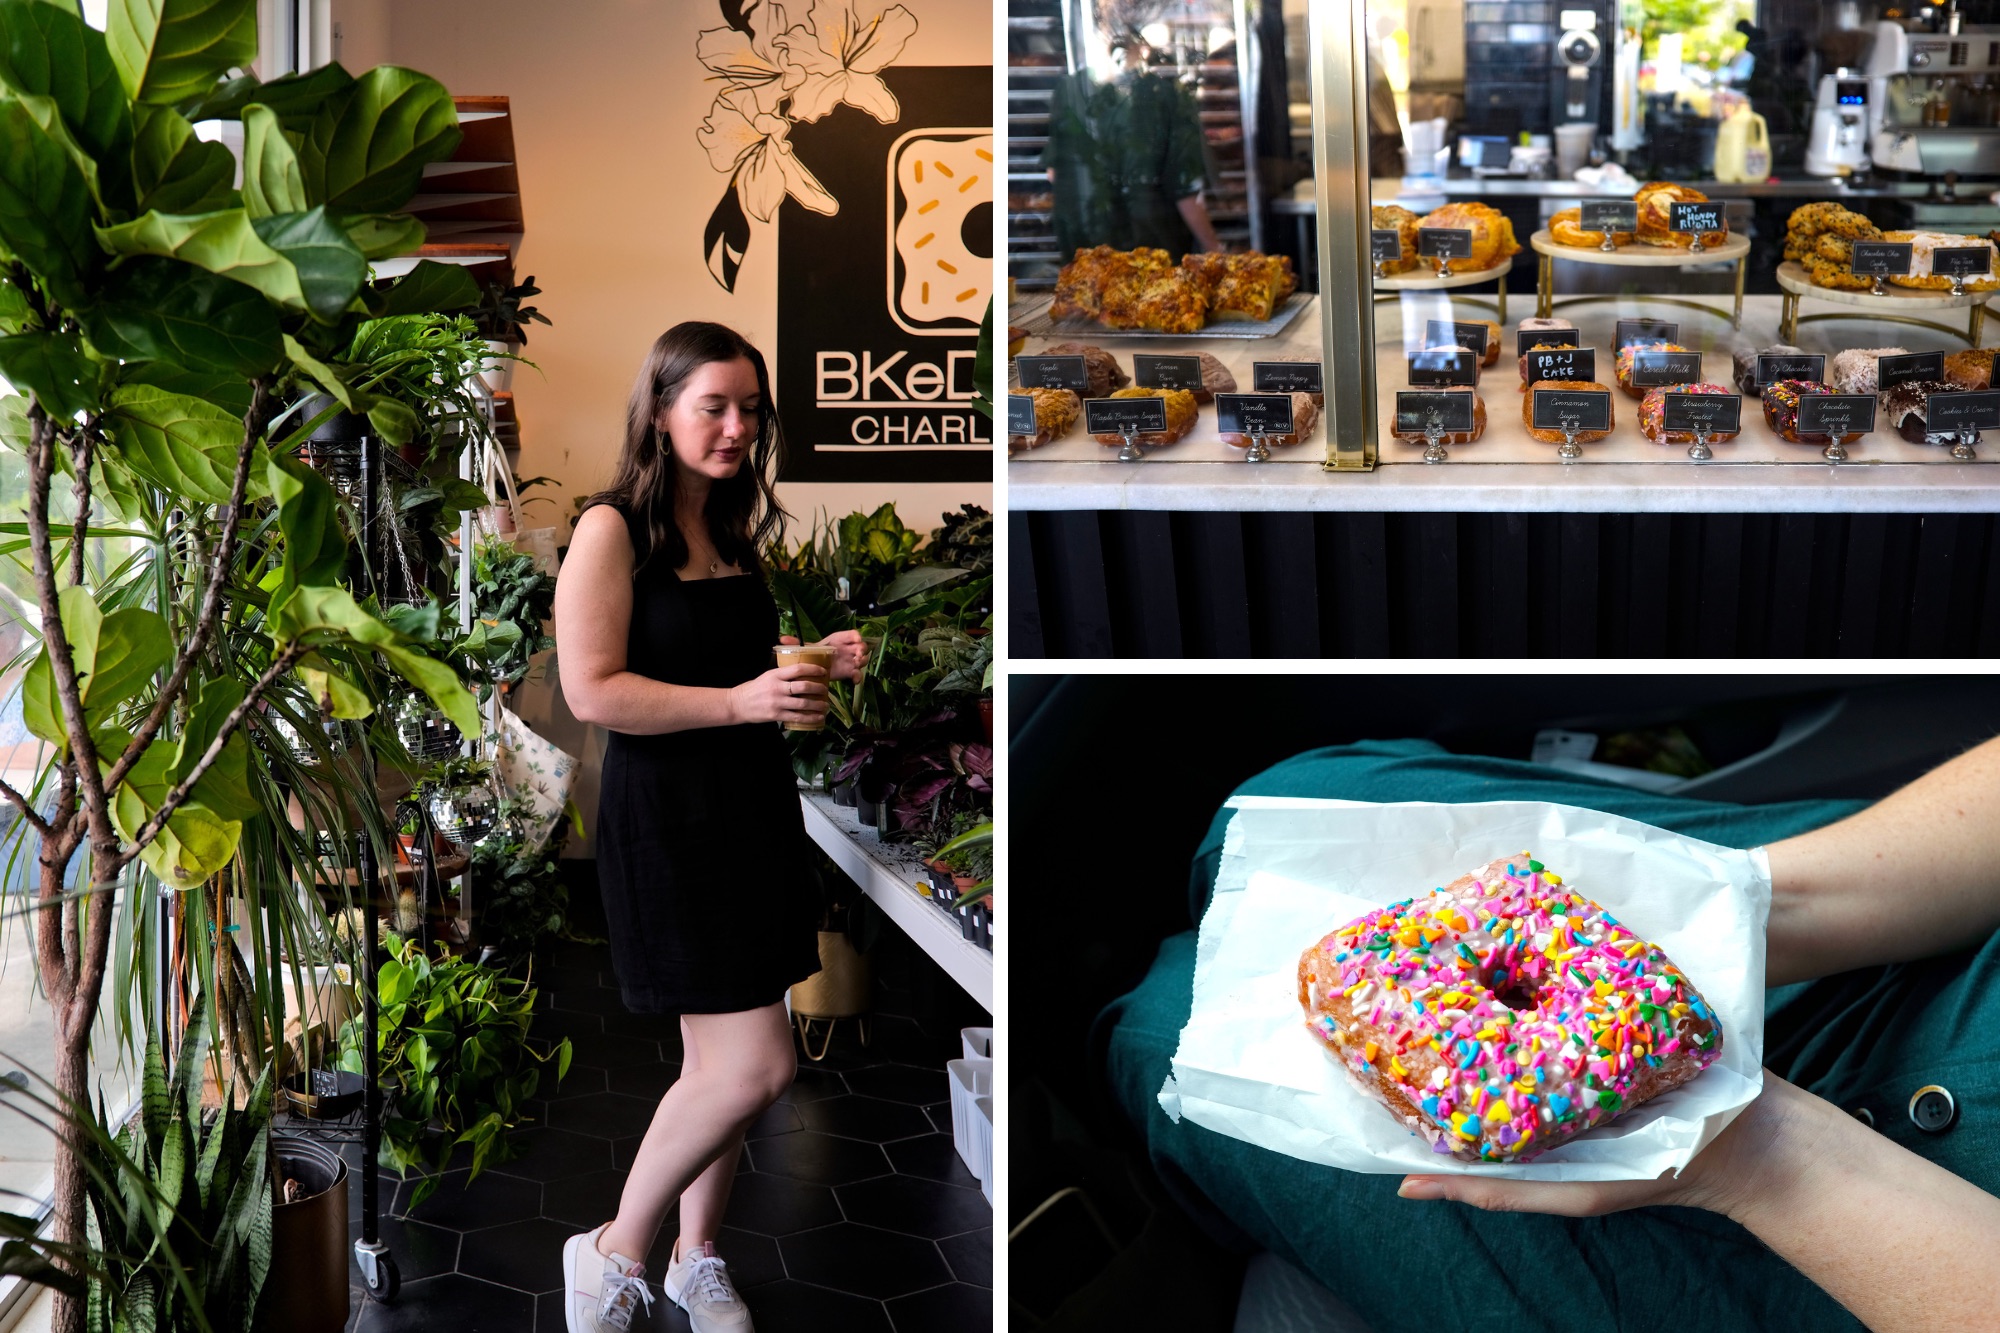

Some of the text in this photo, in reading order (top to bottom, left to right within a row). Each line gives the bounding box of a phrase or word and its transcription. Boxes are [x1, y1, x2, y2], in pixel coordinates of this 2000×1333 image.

[1678, 205, 1698, 215] HOT
[1888, 250, 1900, 258] Chip
[1039, 364, 1059, 373] Apple
[1643, 364, 1690, 374] Cereal Milk
[1782, 364, 1814, 372] Chocolate
[1915, 365, 1936, 373] Cream
[1542, 367, 1575, 379] CAKE
[1240, 403, 1267, 411] Vanilla
[1551, 398, 1590, 407] Cinnamon
[1681, 399, 1724, 411] Strawberry
[1818, 402, 1852, 410] Chocolate
[1091, 412, 1162, 422] Maple Brown Sugar
[1244, 415, 1264, 423] Bean
[1558, 411, 1580, 421] Sugar
[1687, 412, 1712, 421] Frosted
[1819, 414, 1851, 424] Sprinkle
[852, 415, 991, 444] CHARL
